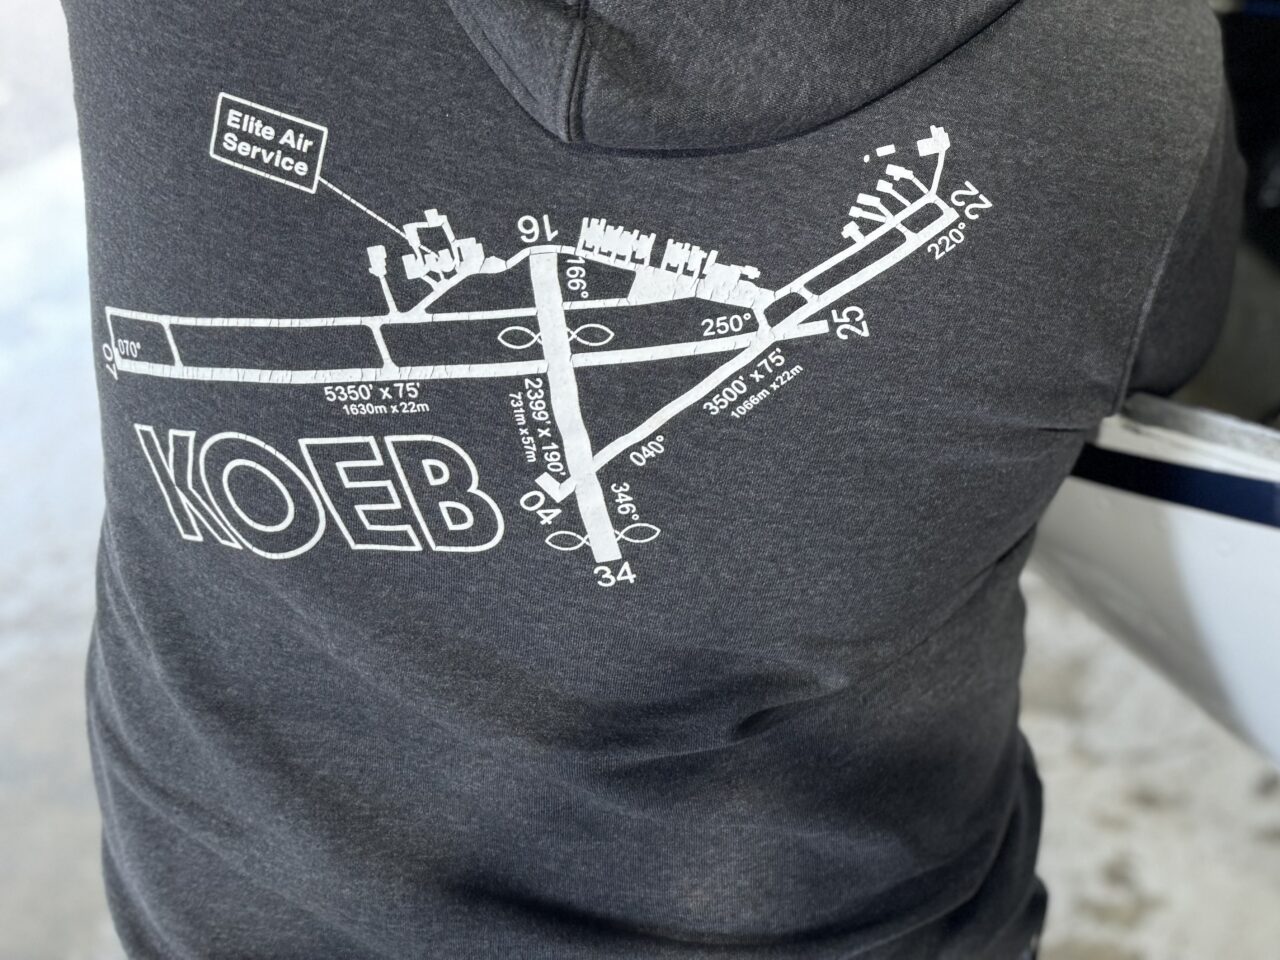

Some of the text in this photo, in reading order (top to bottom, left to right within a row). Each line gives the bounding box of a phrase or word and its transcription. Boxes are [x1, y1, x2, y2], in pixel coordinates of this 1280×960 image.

[227, 109, 314, 153] Elite Air
[222, 132, 309, 176] Service
[950, 180, 992, 220] 22
[517, 214, 560, 243] 16
[926, 222, 968, 260] 220°
[701, 312, 752, 336] 250°
[831, 305, 870, 340] 25
[102, 343, 119, 381] 07
[342, 403, 387, 416] 1630m
[509, 392, 526, 426] 731m
[730, 388, 770, 419] 1066m
[629, 435, 665, 466] 040°
[134, 423, 505, 559] KOEB
[519, 490, 562, 526] 04
[611, 482, 640, 521] 346°
[594, 561, 636, 586] 34
